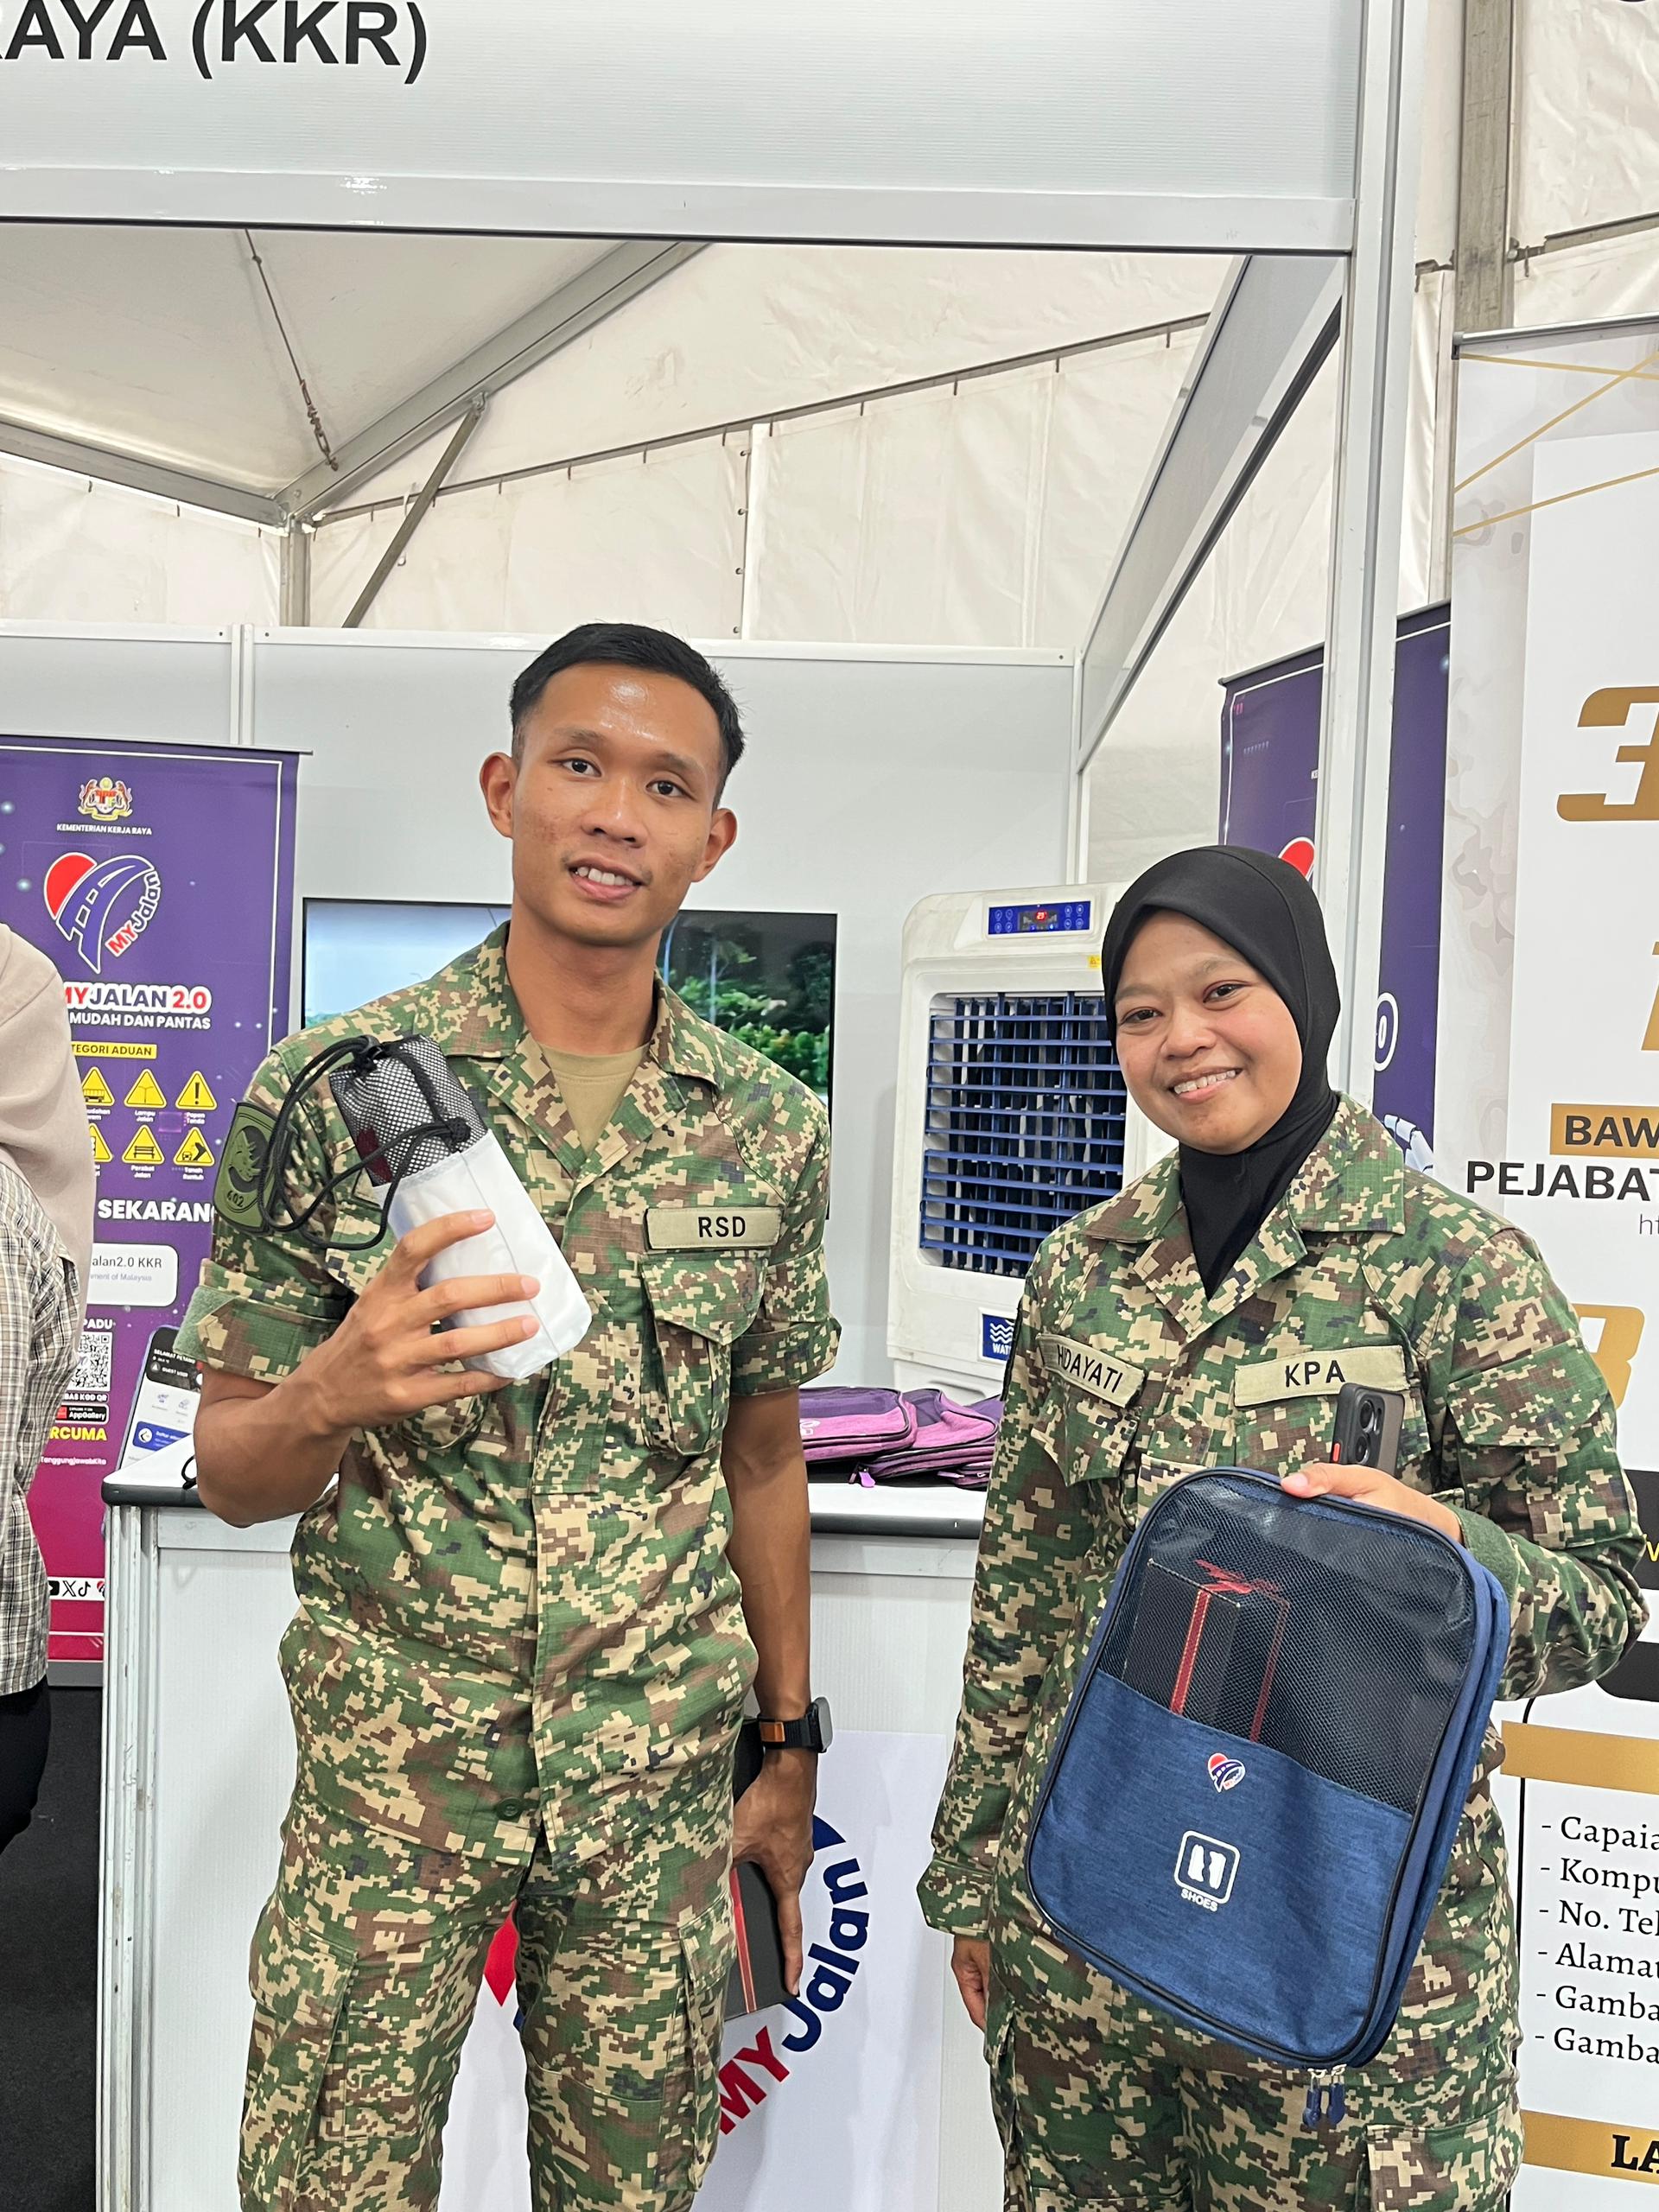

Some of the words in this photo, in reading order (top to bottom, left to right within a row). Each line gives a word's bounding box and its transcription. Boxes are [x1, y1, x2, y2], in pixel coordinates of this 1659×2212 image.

[0, 0, 168, 60] AYA
[192, 0, 427, 85] (KKR)
[56, 823, 107, 833] KEMENTERIAN
[107, 826, 130, 835] KERJA
[105, 871, 161, 956] MYJalan
[172, 990, 207, 1010] 2.0
[69, 1012, 121, 1026] MUDAH
[124, 1015, 154, 1027] DAN
[156, 1017, 212, 1030] PANTAS
[111, 1047, 152, 1056] ADUAN
[226, 1190, 245, 1208] 602
[698, 1216, 746, 1238] RSD
[138, 1257, 162, 1268] KKR
[1285, 1359, 1345, 1387] KPA
[69, 1412, 105, 1421] AppGallery
[1180, 1888, 1218, 1912] SHOES
[1559, 1899, 1609, 1929] No.
